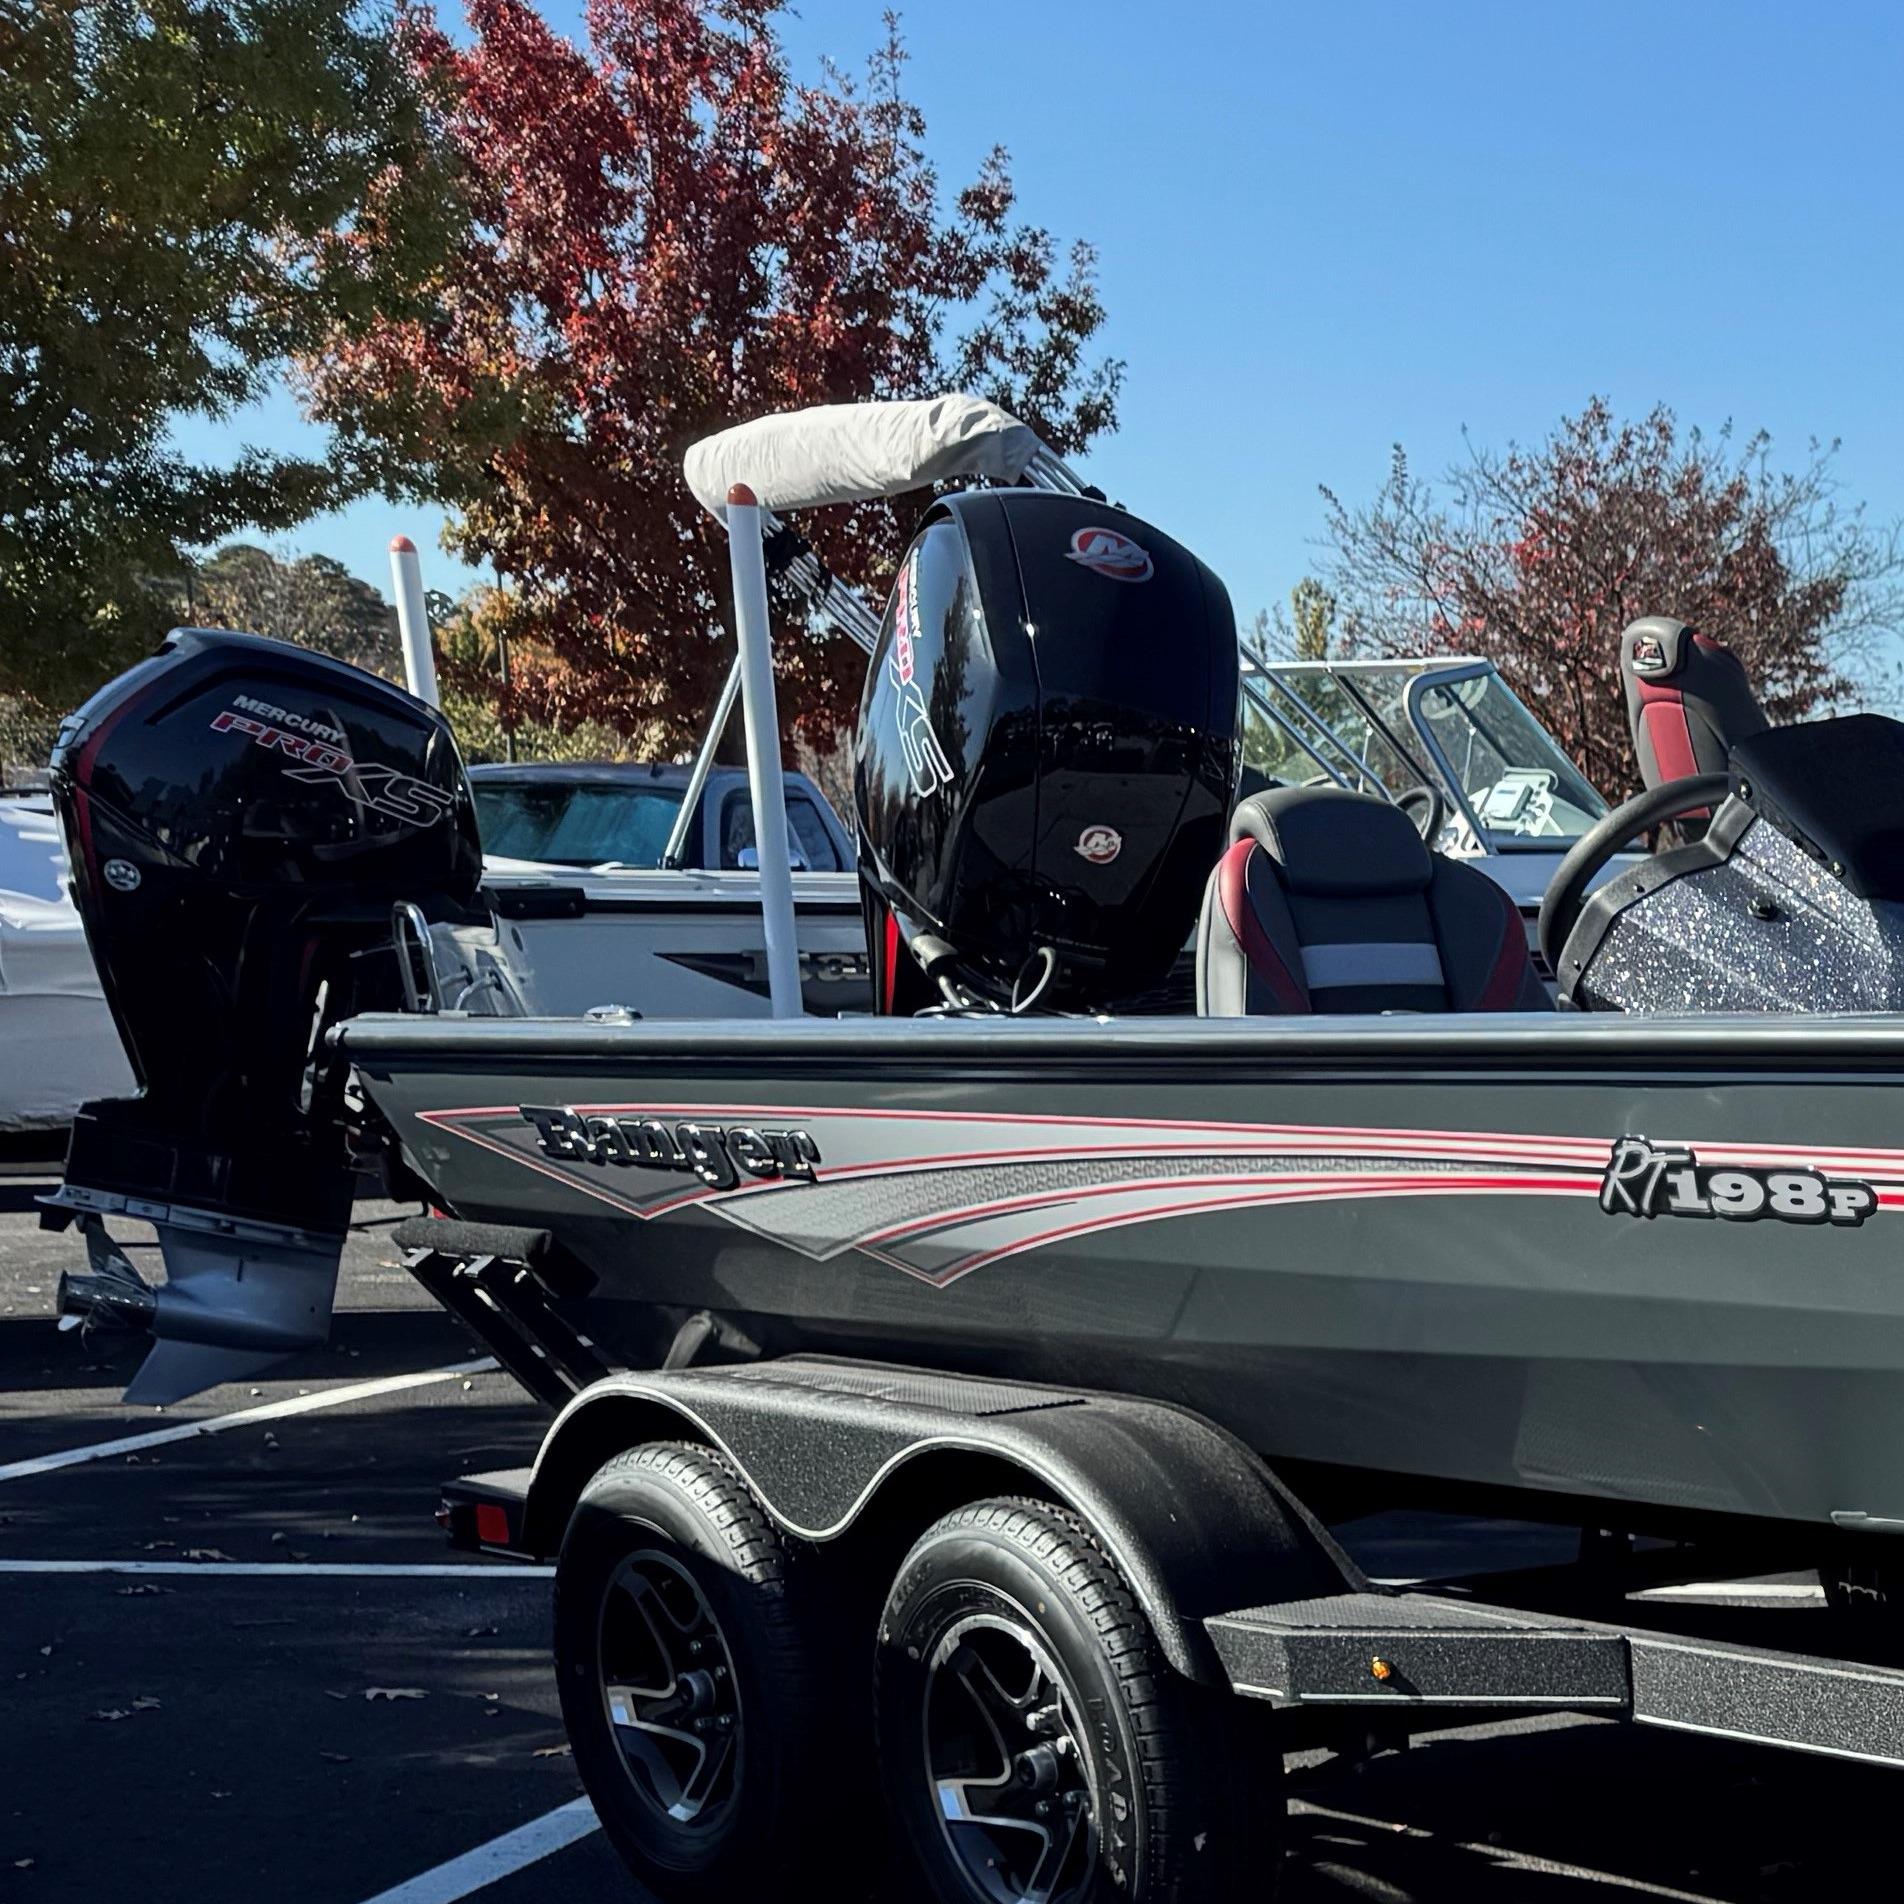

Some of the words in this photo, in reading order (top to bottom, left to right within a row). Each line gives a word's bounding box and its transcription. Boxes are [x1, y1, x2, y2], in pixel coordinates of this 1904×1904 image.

[209, 711, 354, 775] PRO
[232, 695, 347, 742] MERCURY
[281, 762, 454, 828] XS
[518, 1103, 822, 1192] Ranger
